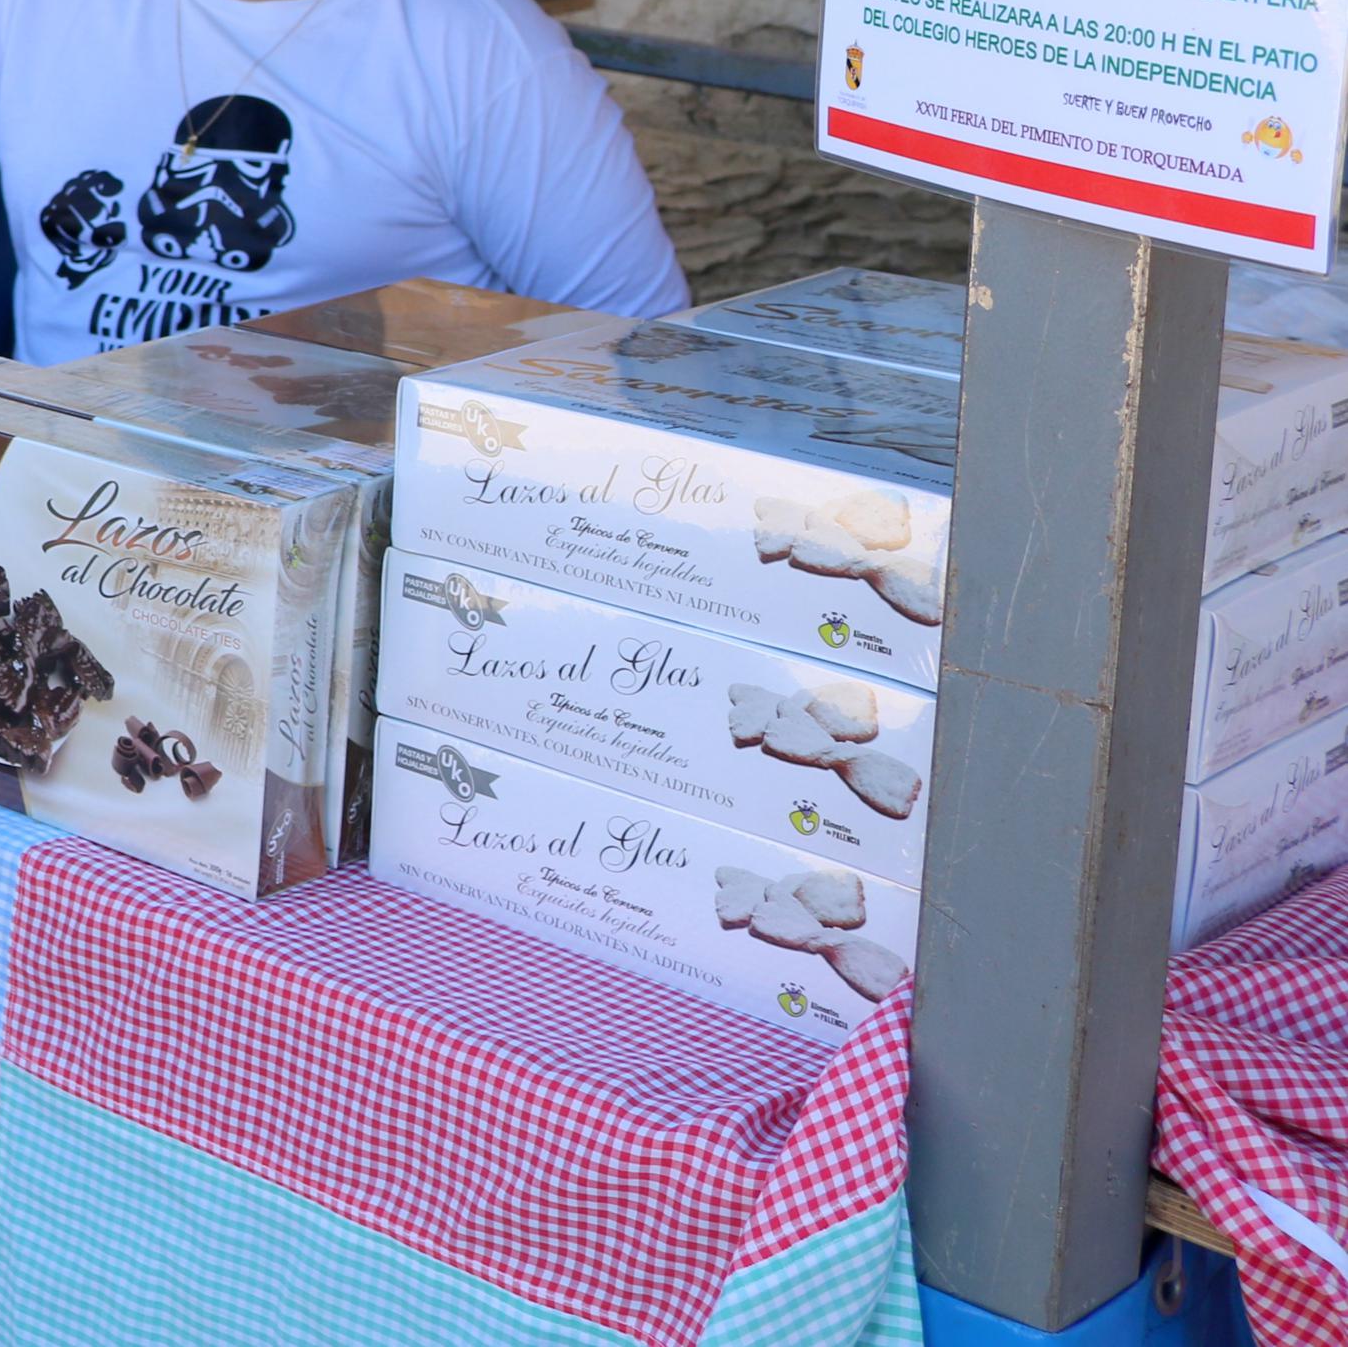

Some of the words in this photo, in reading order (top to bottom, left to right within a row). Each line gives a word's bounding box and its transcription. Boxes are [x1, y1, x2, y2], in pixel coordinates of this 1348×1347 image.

[863, 7, 889, 29] DEL
[892, 14, 961, 45] COLEGIO
[965, 30, 1037, 60] HEROES
[1042, 43, 1068, 66] DE
[1073, 48, 1097, 72] LA
[1101, 54, 1278, 102] INDEPENDENCIA
[1045, 14, 1058, 32] A
[1063, 16, 1099, 40] LAS
[1104, 23, 1155, 49] 20:00
[1161, 32, 1177, 52] H
[1182, 35, 1212, 58] EN
[1219, 40, 1246, 64] EL
[1252, 45, 1319, 74] PATIO
[916, 100, 948, 121] XXVII
[950, 108, 987, 130] FERIA
[991, 117, 1018, 137] DEL
[1020, 124, 1094, 153] PIMIENTO
[1096, 139, 1118, 158] DE
[1121, 144, 1245, 183] TORQUEMADA
[1062, 92, 1102, 112] SUERTE
[1104, 98, 1114, 116] Y
[1116, 100, 1148, 120] BUEN
[1151, 106, 1213, 132] PROVECHO
[139, 264, 232, 302] YOUR
[462, 458, 567, 505] Lazos
[579, 464, 620, 504] al
[633, 455, 729, 515] Glas
[1221, 456, 1267, 502] Lazos
[1270, 427, 1288, 470] al
[42, 480, 209, 560] Lazos
[570, 515, 614, 542] Típicos
[616, 529, 631, 544] de
[633, 529, 690, 559] Cervera
[61, 554, 98, 586] al
[98, 557, 254, 617] Chocolate
[419, 527, 444, 543] SIN
[447, 533, 559, 575] CONSERVANTES,
[563, 563, 663, 599] COLORANTES
[666, 588, 683, 606] NI
[684, 593, 761, 626] ADITIVOS
[544, 525, 630, 567] Exquisitos
[632, 550, 714, 588] hojaldres
[131, 608, 209, 640] CHOCOLATE
[212, 631, 242, 650] TIES
[303, 612, 319, 714] Chocolate
[446, 631, 548, 680] Lazos
[558, 644, 596, 683] al
[610, 637, 704, 696] Glas
[279, 653, 305, 768] Lazos
[437, 802, 538, 854] Lazos
[547, 821, 586, 858] al
[598, 815, 690, 873] Glas
